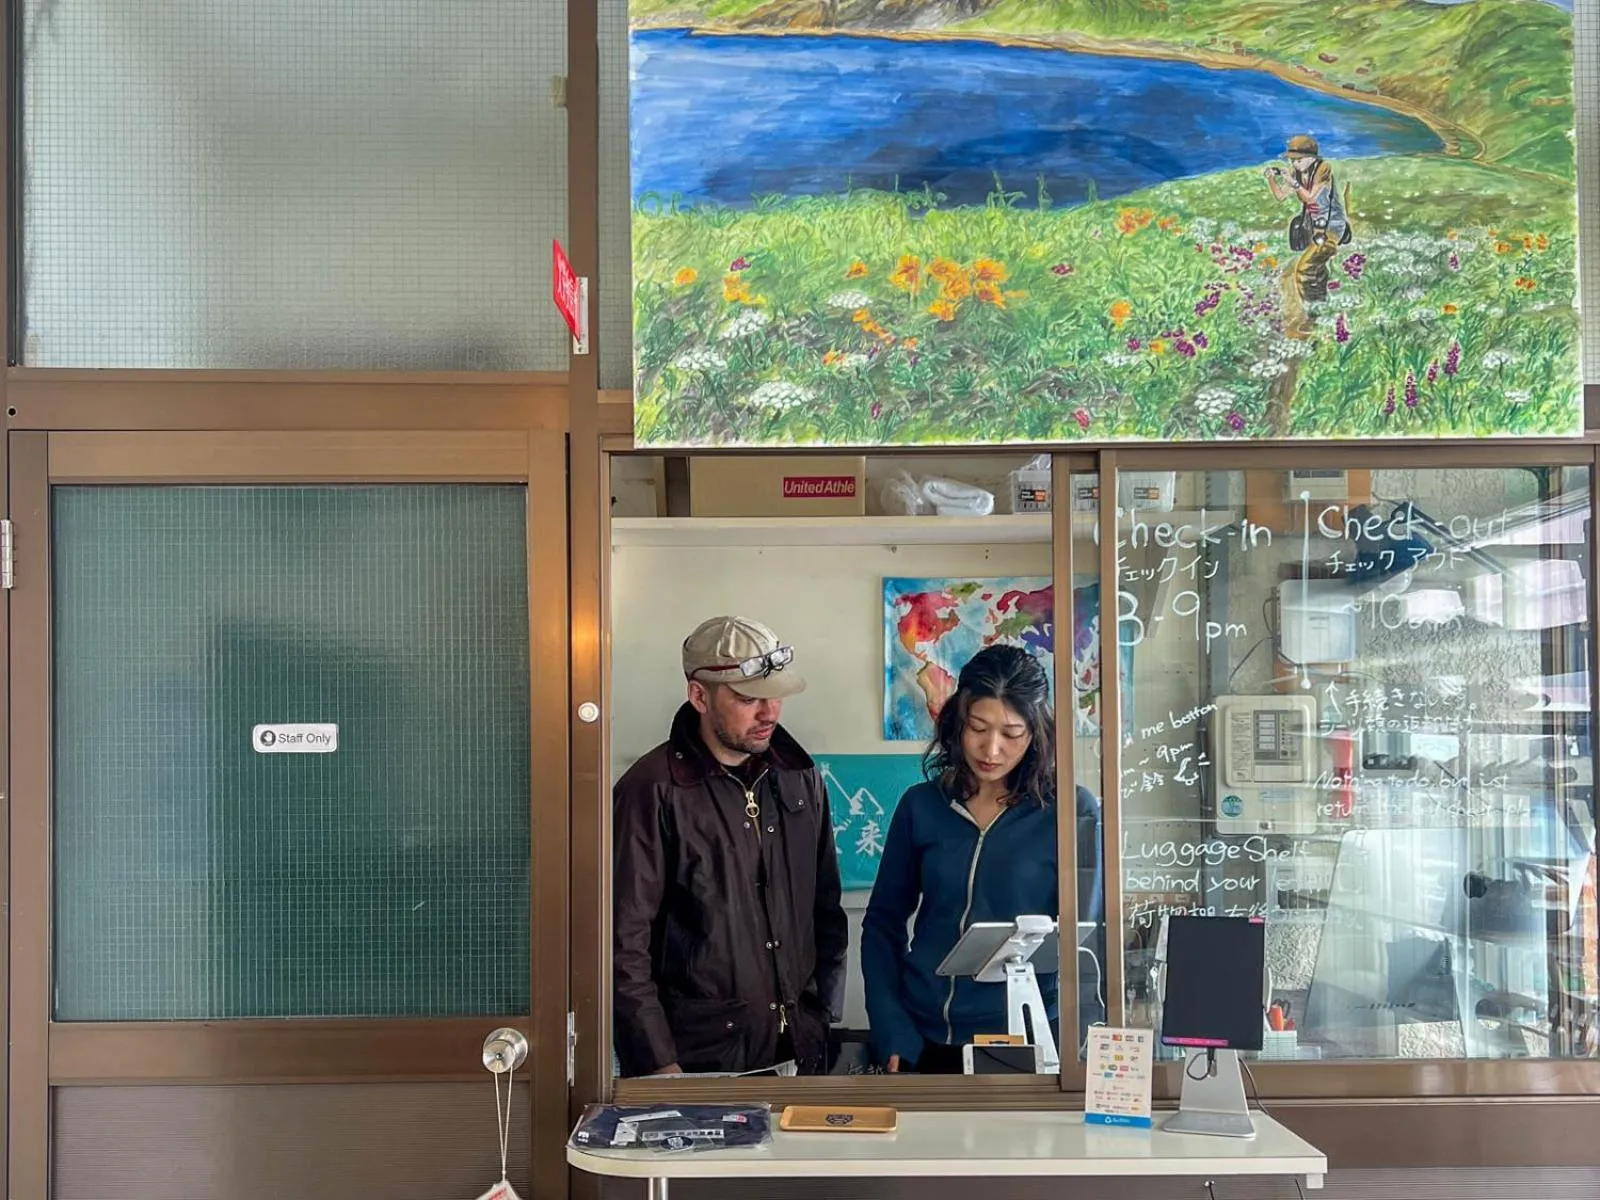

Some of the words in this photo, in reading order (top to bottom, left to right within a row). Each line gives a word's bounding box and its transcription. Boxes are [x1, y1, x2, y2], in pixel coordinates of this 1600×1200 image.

[785, 480, 824, 494] United
[824, 480, 855, 494] Athle
[1317, 501, 1512, 541] Check-out
[278, 734, 304, 744] Staff
[306, 733, 331, 746] Only
[1121, 831, 1241, 866] Luggage
[1243, 836, 1313, 862] Shelf
[1124, 869, 1201, 893] behind
[1206, 876, 1261, 893] your
